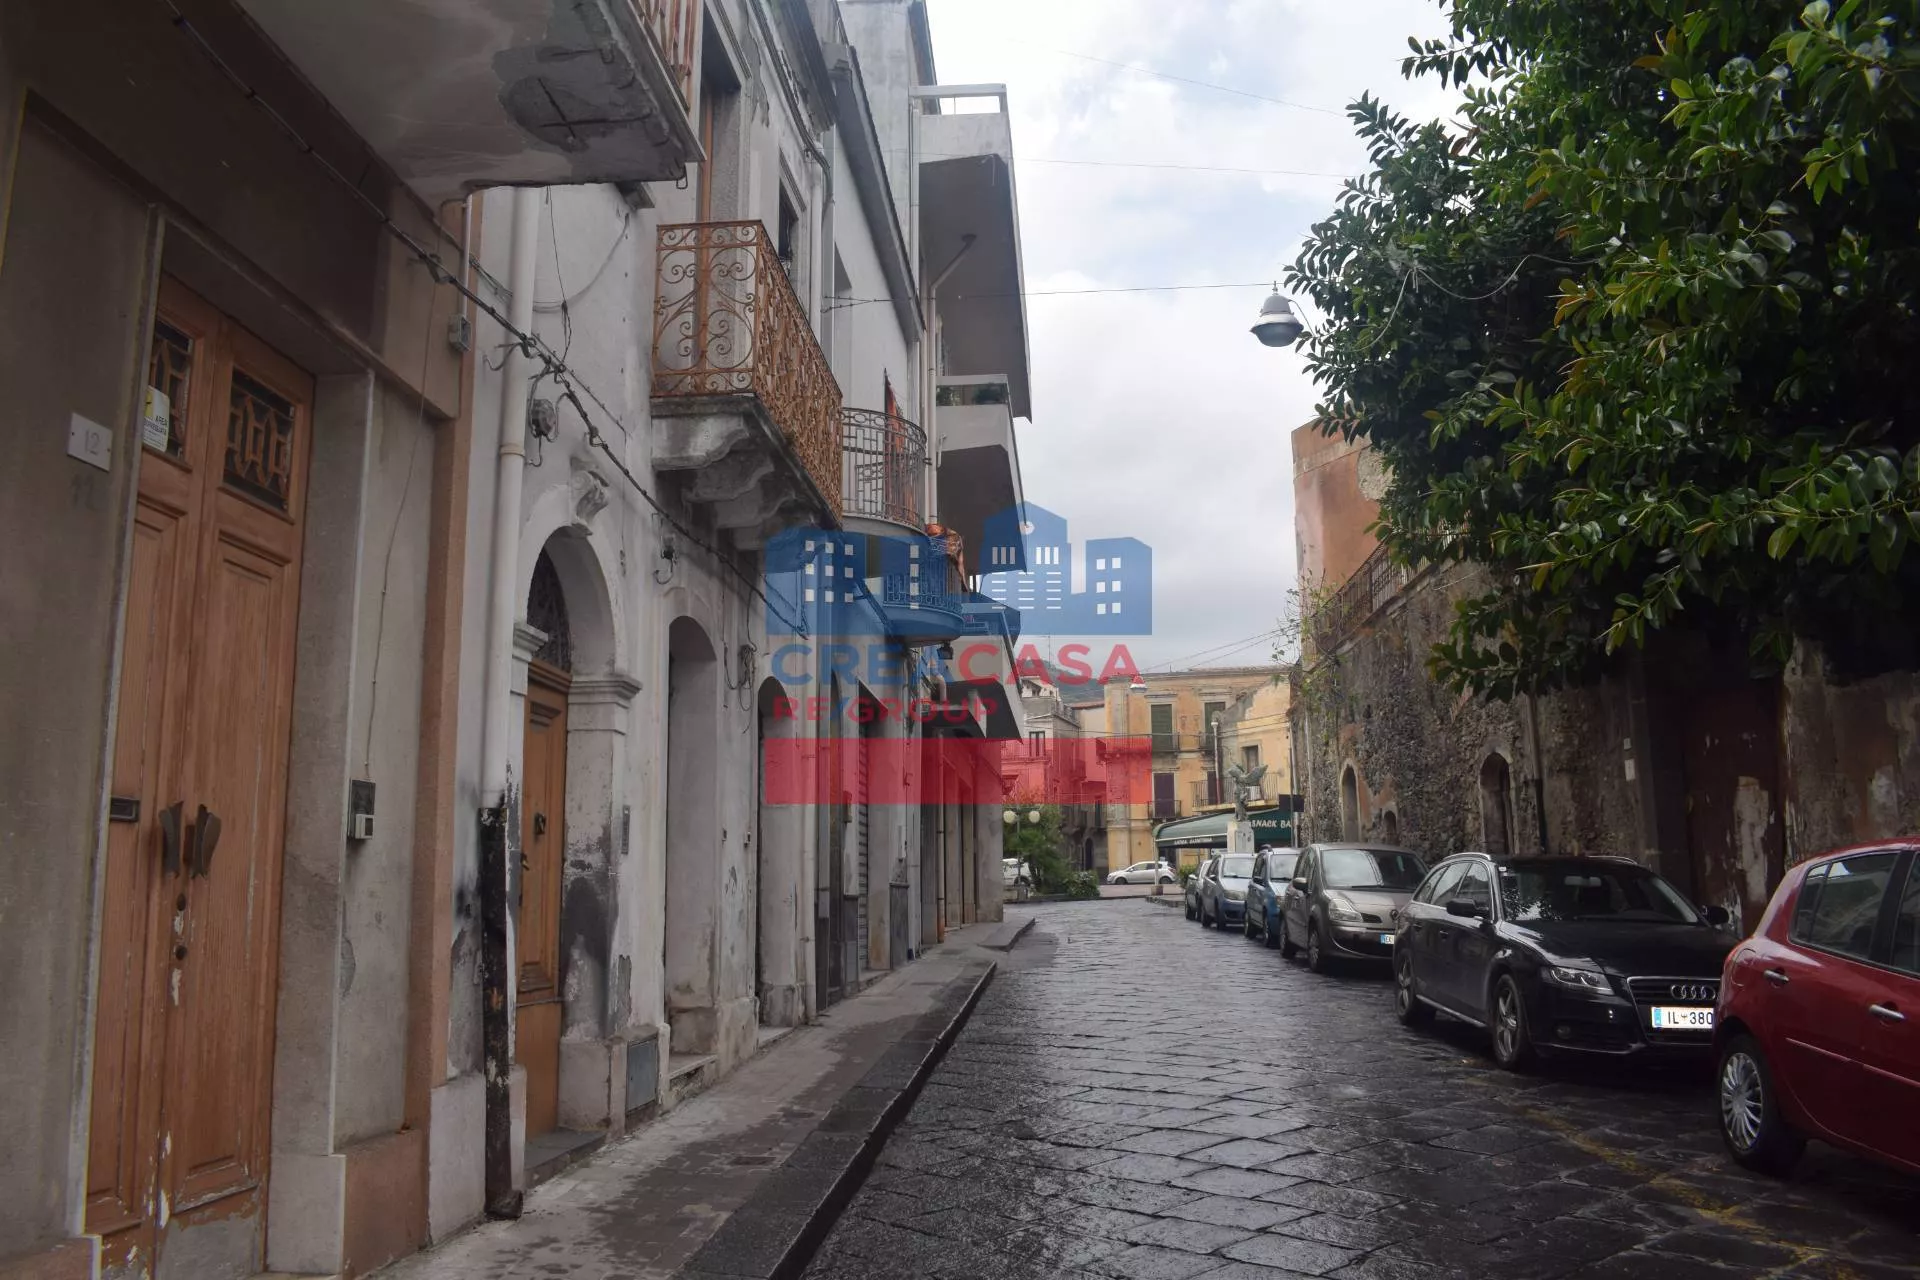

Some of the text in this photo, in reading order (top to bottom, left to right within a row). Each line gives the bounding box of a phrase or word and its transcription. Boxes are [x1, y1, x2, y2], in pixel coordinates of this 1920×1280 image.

[85, 428, 101, 456] 12
[1251, 819, 1292, 829] SNACK BA
[1667, 1011, 1713, 1025] IL 380
